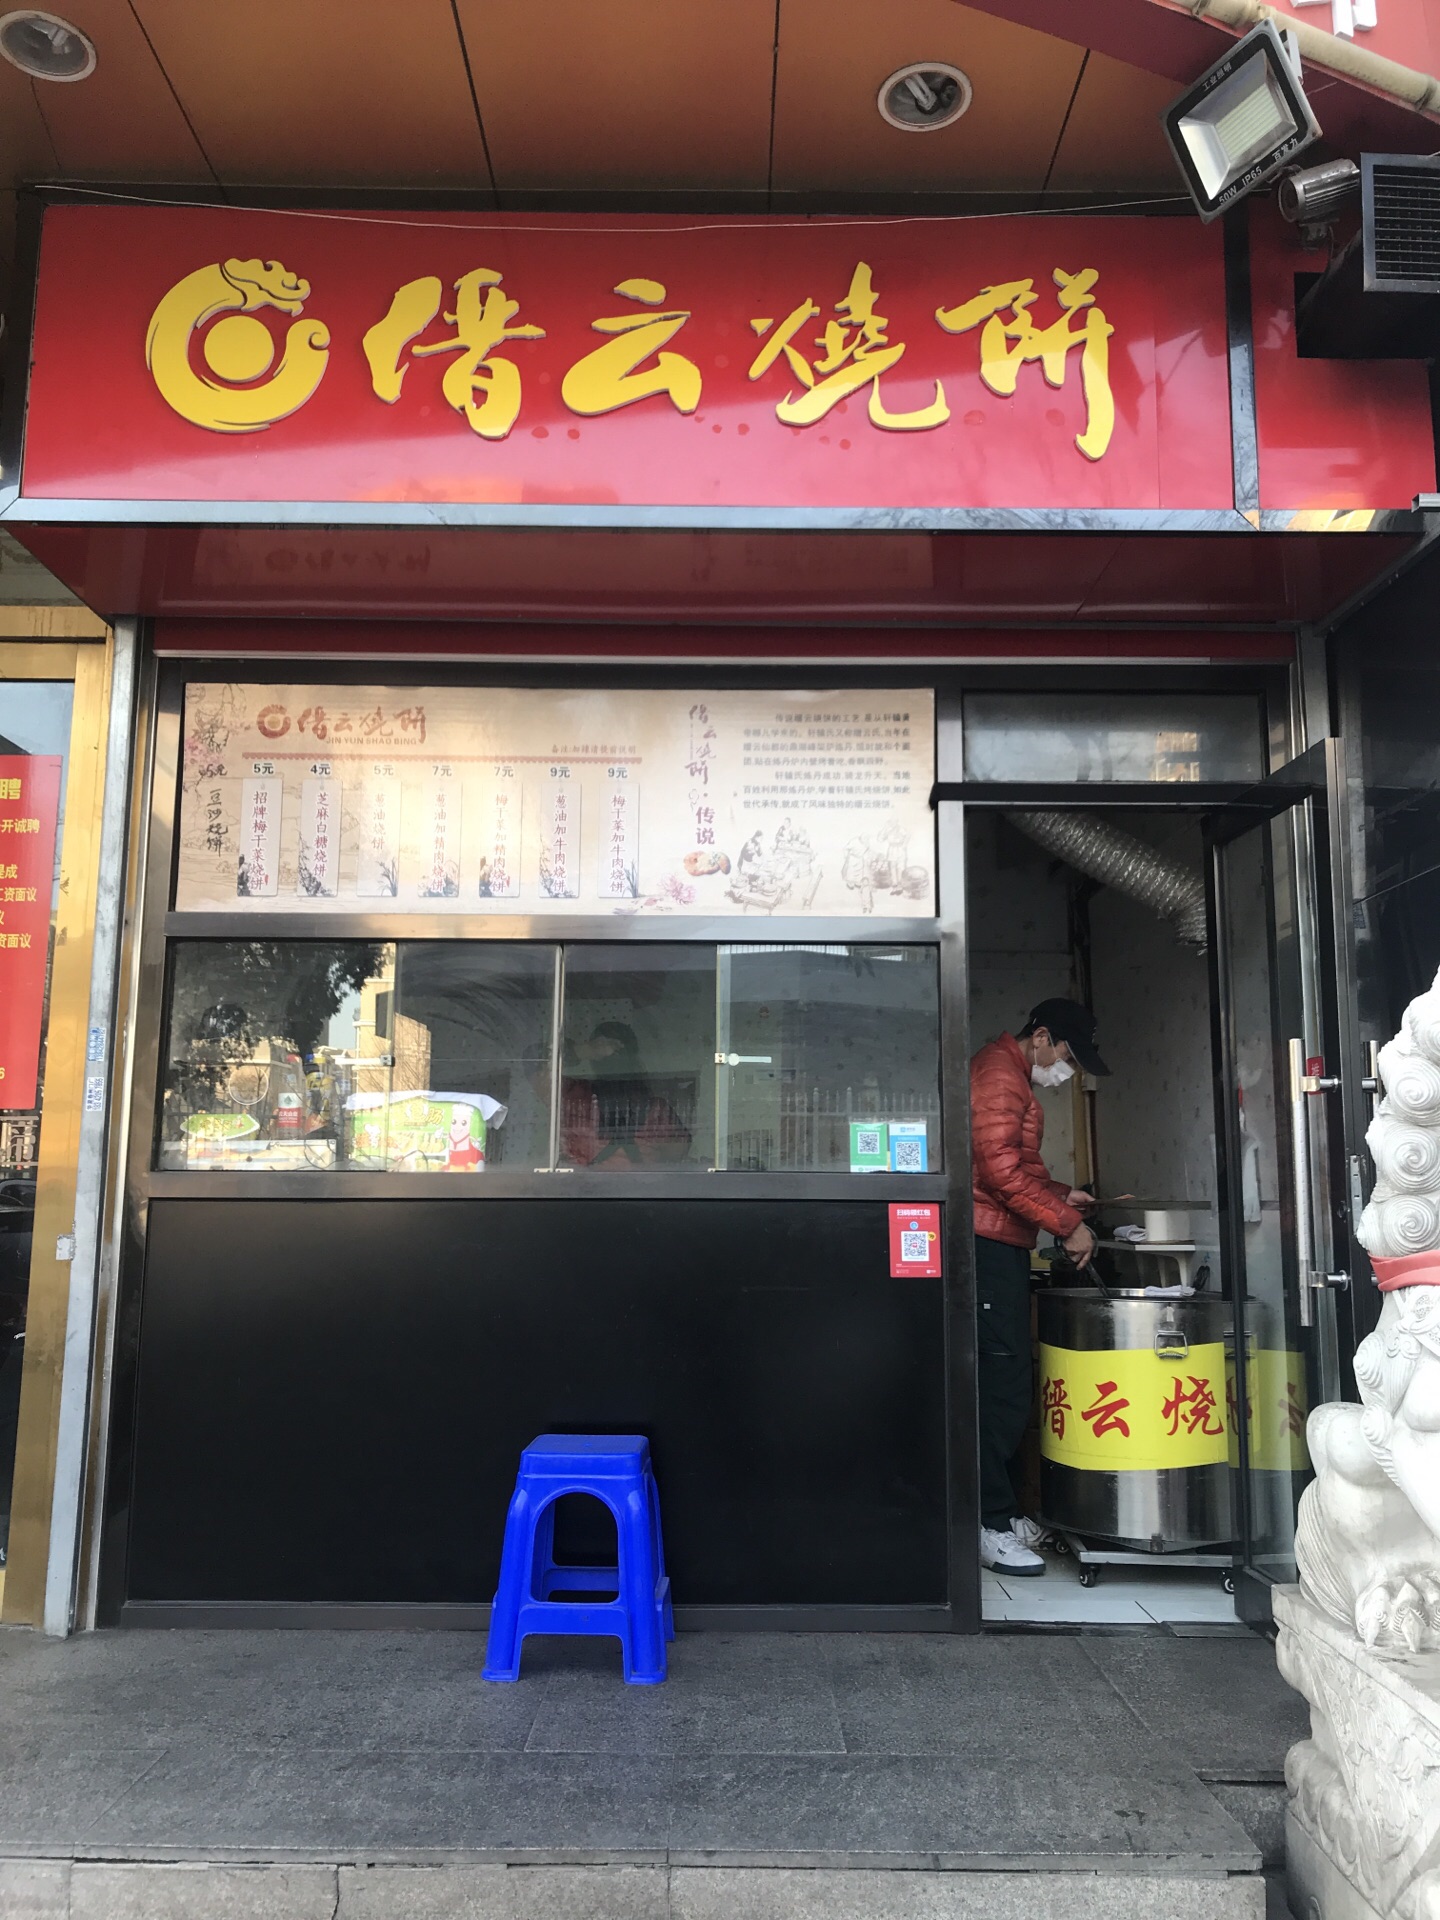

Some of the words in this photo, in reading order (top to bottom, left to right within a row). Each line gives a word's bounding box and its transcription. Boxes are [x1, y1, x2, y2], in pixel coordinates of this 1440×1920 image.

[1202, 62, 1232, 91] 工业照明
[1218, 185, 1238, 206] 50W
[1241, 165, 1263, 188] IP65
[326, 737, 342, 745] JIN
[344, 737, 364, 745] YUN
[366, 737, 392, 745] SHAO
[393, 737, 417, 745] BING
[253, 763, 275, 775] 5元
[310, 763, 331, 776] 4元
[373, 765, 394, 776] 5元
[432, 765, 452, 777] 7元
[494, 766, 514, 778] 7元
[550, 766, 571, 778] 9元
[607, 766, 628, 779] 9元
[0, 819, 41, 834] 开诚聘
[206, 788, 228, 858] 豆沙烧饼
[372, 793, 387, 850] 葱油烧饼
[249, 791, 268, 892] 招牌梅干菜烧饼
[312, 792, 330, 878] 芝麻白糖烧饼
[430, 793, 447, 893] 葱油加精肉烧饼
[491, 793, 509, 893] 梅干菜加精肉烧饼
[552, 794, 569, 892] 葱油加牛肉烧饼
[608, 794, 627, 894] 梅干菜加牛肉烧饼
[0, 887, 37, 902] 资面议
